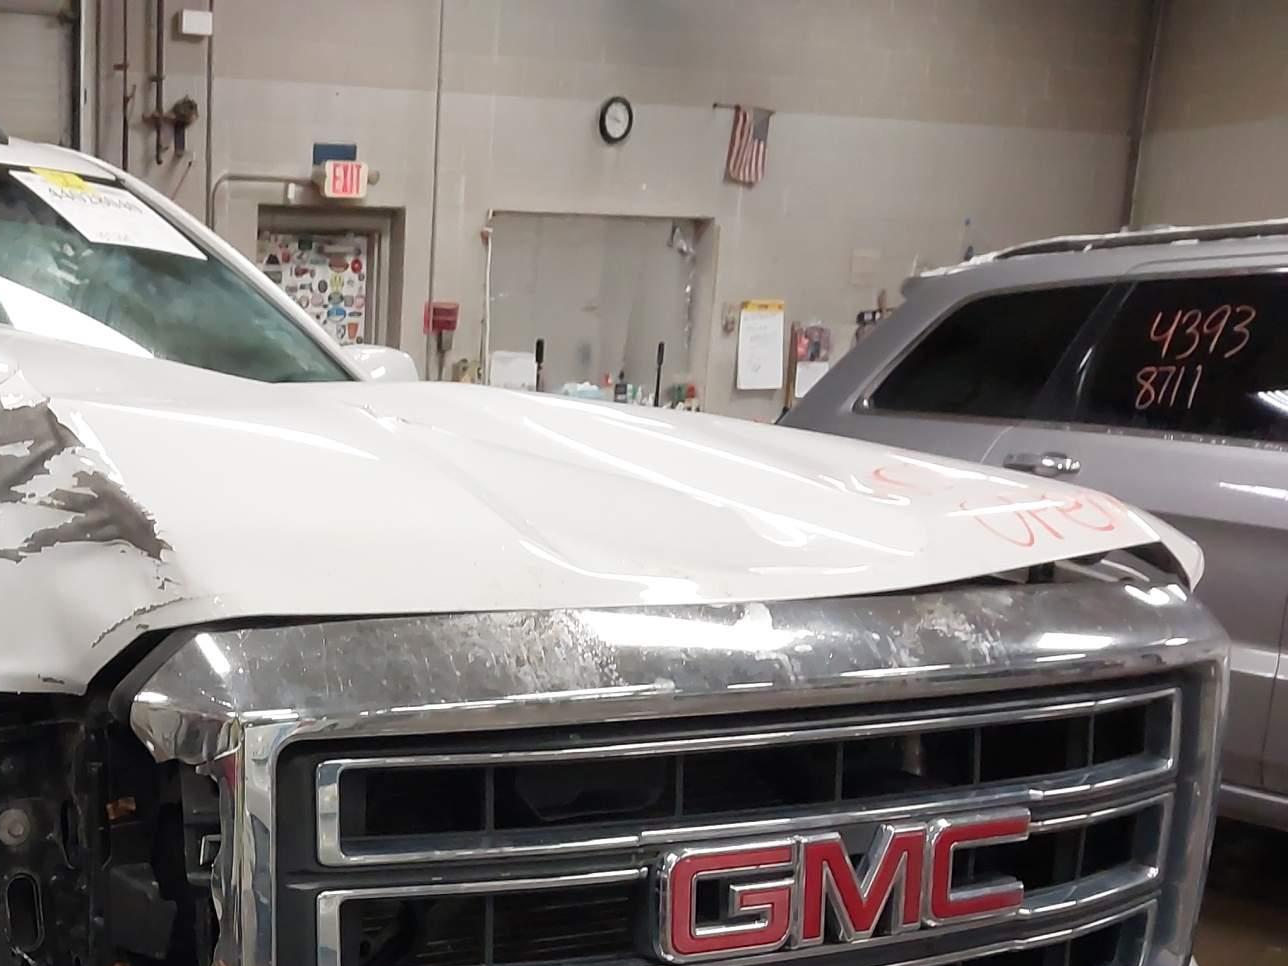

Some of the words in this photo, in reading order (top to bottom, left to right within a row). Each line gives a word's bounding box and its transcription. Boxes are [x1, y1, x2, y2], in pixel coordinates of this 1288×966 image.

[331, 162, 362, 195] EXIT
[1149, 303, 1258, 361] 4393
[1134, 364, 1205, 411] 8711
[654, 807, 1032, 964] GMC
